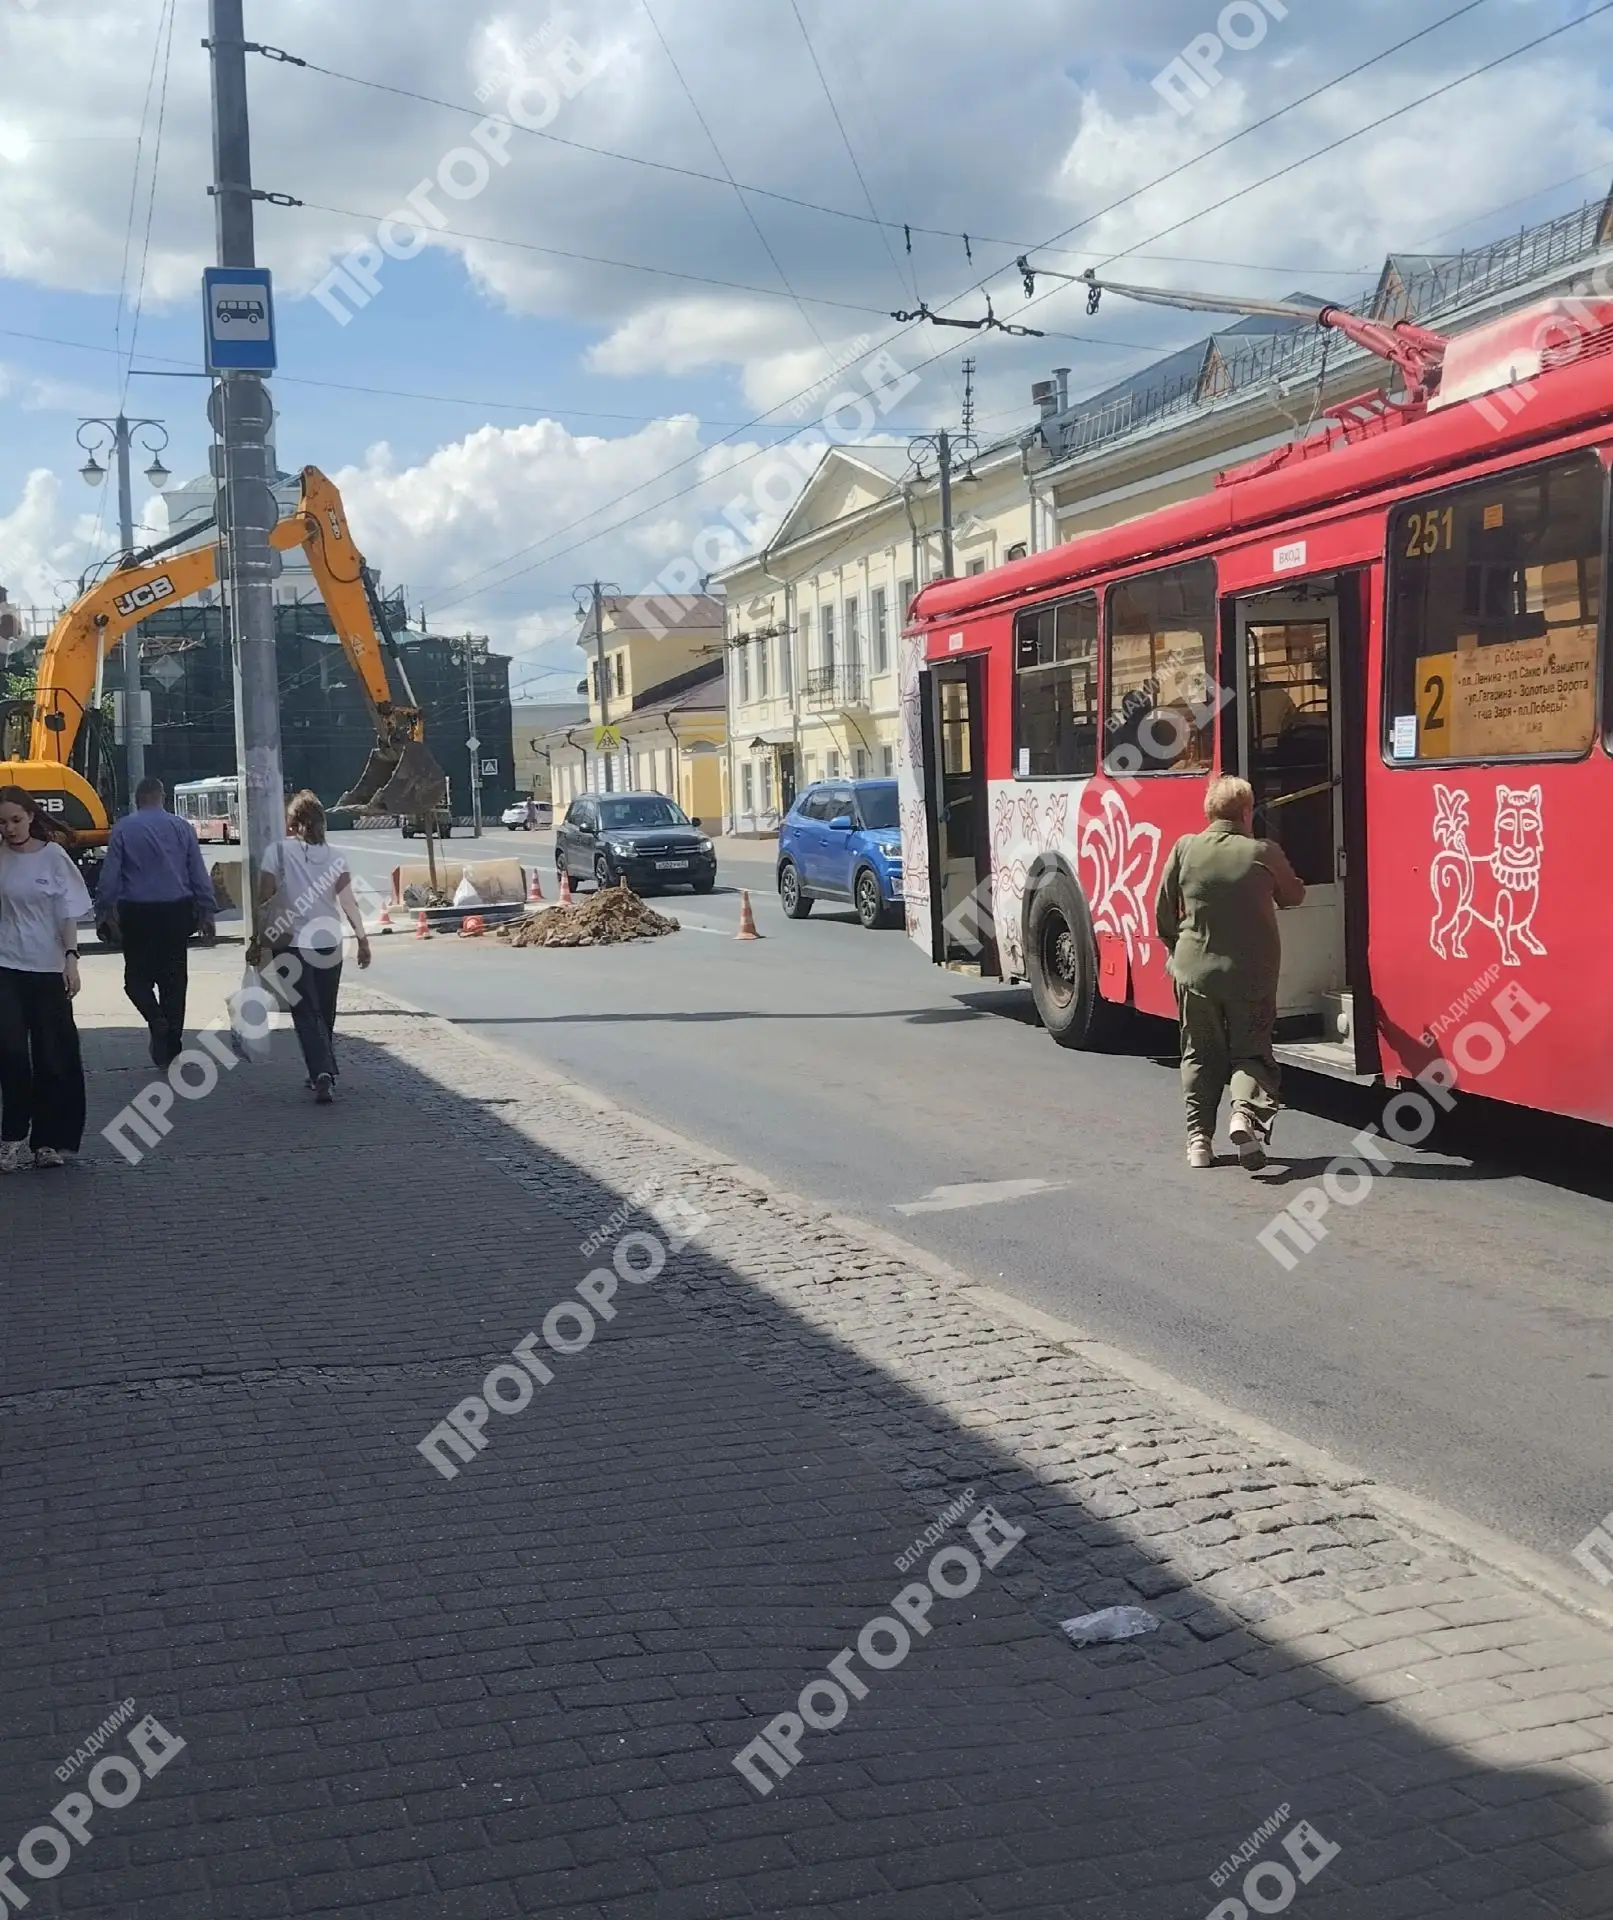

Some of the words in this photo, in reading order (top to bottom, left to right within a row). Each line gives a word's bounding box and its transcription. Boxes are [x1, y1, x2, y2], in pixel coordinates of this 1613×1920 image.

[1406, 507, 1453, 557] 251
[1279, 549, 1301, 565] ВХОД
[115, 576, 174, 615] JCB
[1475, 672, 1502, 685] Ленина
[1520, 666, 1541, 678] Сакко
[1551, 660, 1590, 675] Ванцетти
[1520, 684, 1555, 697] Золотые
[1557, 679, 1589, 693] Ворота
[1424, 675, 1445, 731] 2
[1494, 705, 1512, 719] Заря
